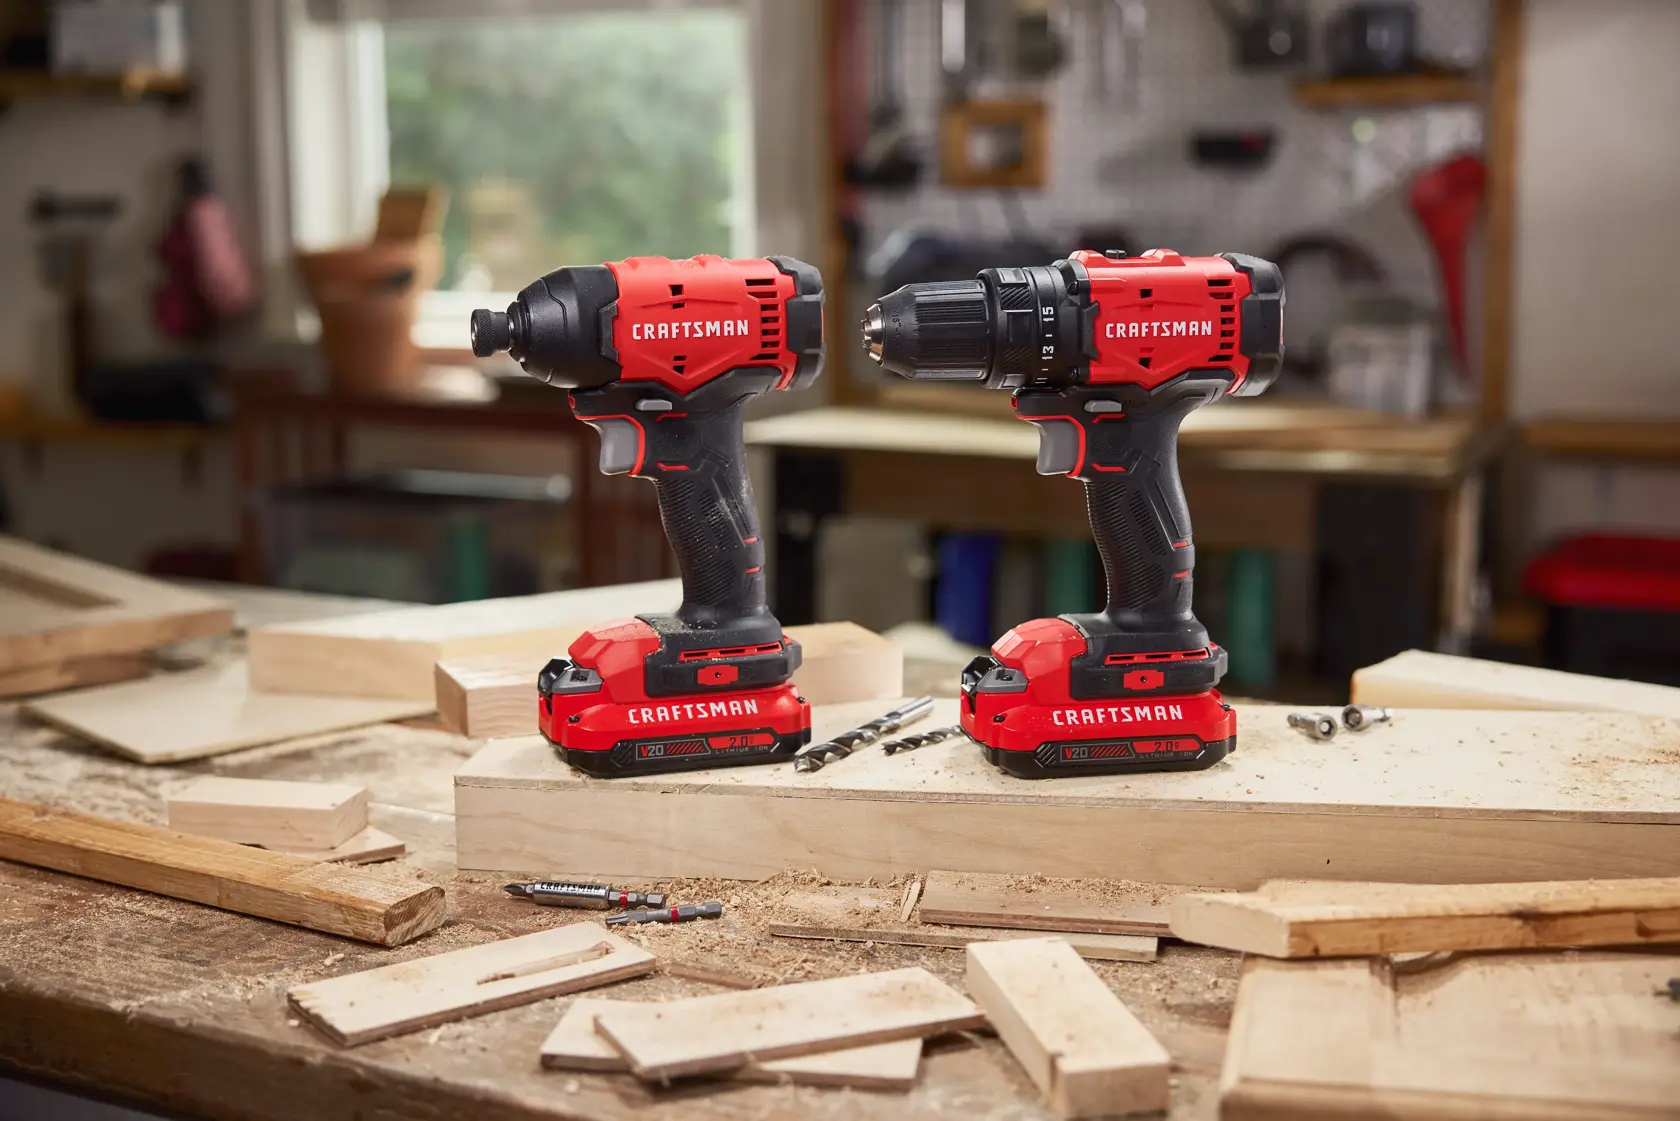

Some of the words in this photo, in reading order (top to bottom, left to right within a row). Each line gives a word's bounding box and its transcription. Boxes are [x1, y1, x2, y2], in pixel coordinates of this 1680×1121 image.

[1042, 306, 1055, 322] 15
[632, 319, 749, 341] CRAFTSMAN
[1105, 320, 1212, 338] CRAFTSMAN
[1041, 345, 1054, 360] 13
[628, 699, 759, 724] CRAFTSMAN
[1052, 704, 1183, 726] CRAFTSMAN
[640, 745, 664, 757] V20
[1064, 746, 1089, 760] V20
[540, 881, 602, 893] CRAFTSMAN
